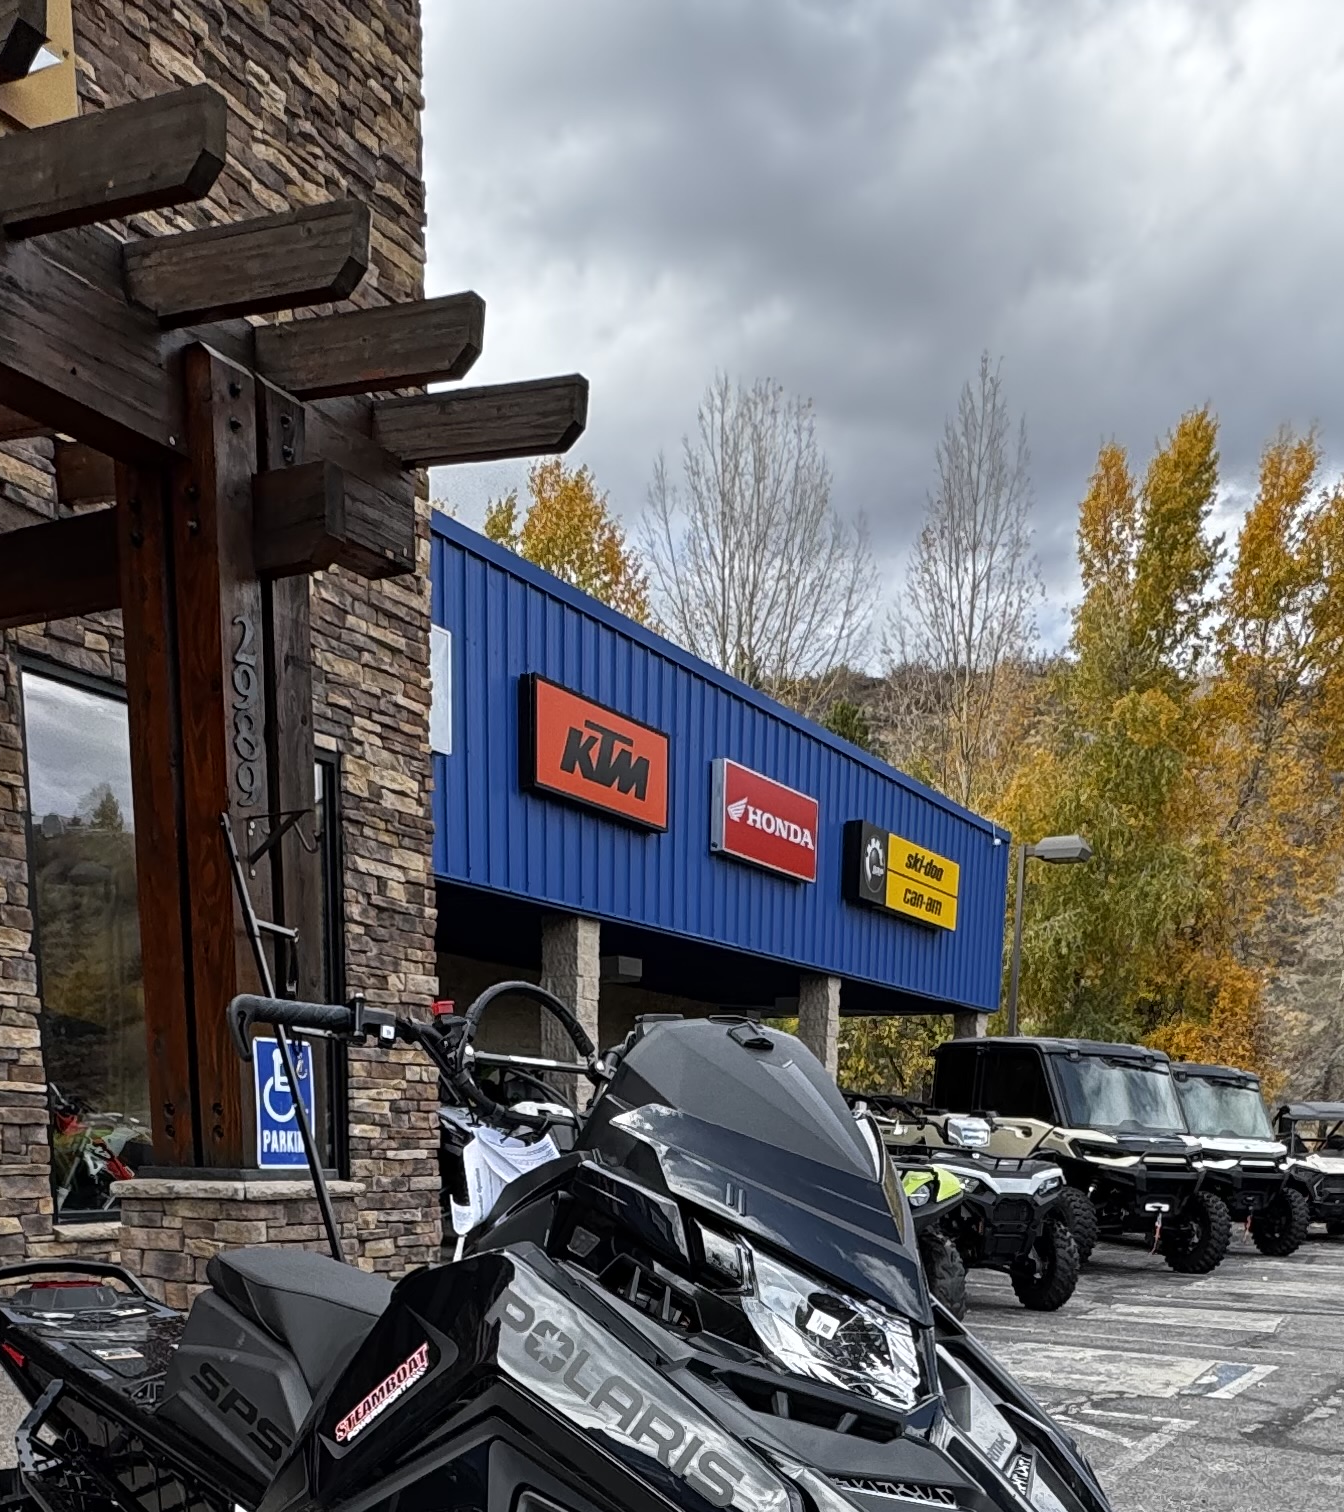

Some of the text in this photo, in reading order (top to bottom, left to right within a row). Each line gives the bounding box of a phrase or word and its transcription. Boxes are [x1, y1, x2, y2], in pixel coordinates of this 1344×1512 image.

[232, 615, 261, 807] 2989
[560, 720, 649, 801] KTM
[746, 803, 815, 850] HONDA
[905, 853, 944, 881] ski-doo
[903, 888, 943, 916] can-am
[263, 1130, 306, 1153] PARKIN
[190, 1362, 293, 1462] SPS
[335, 1341, 429, 1442] STEAMBOAT
[484, 1289, 746, 1508] POLARIS
